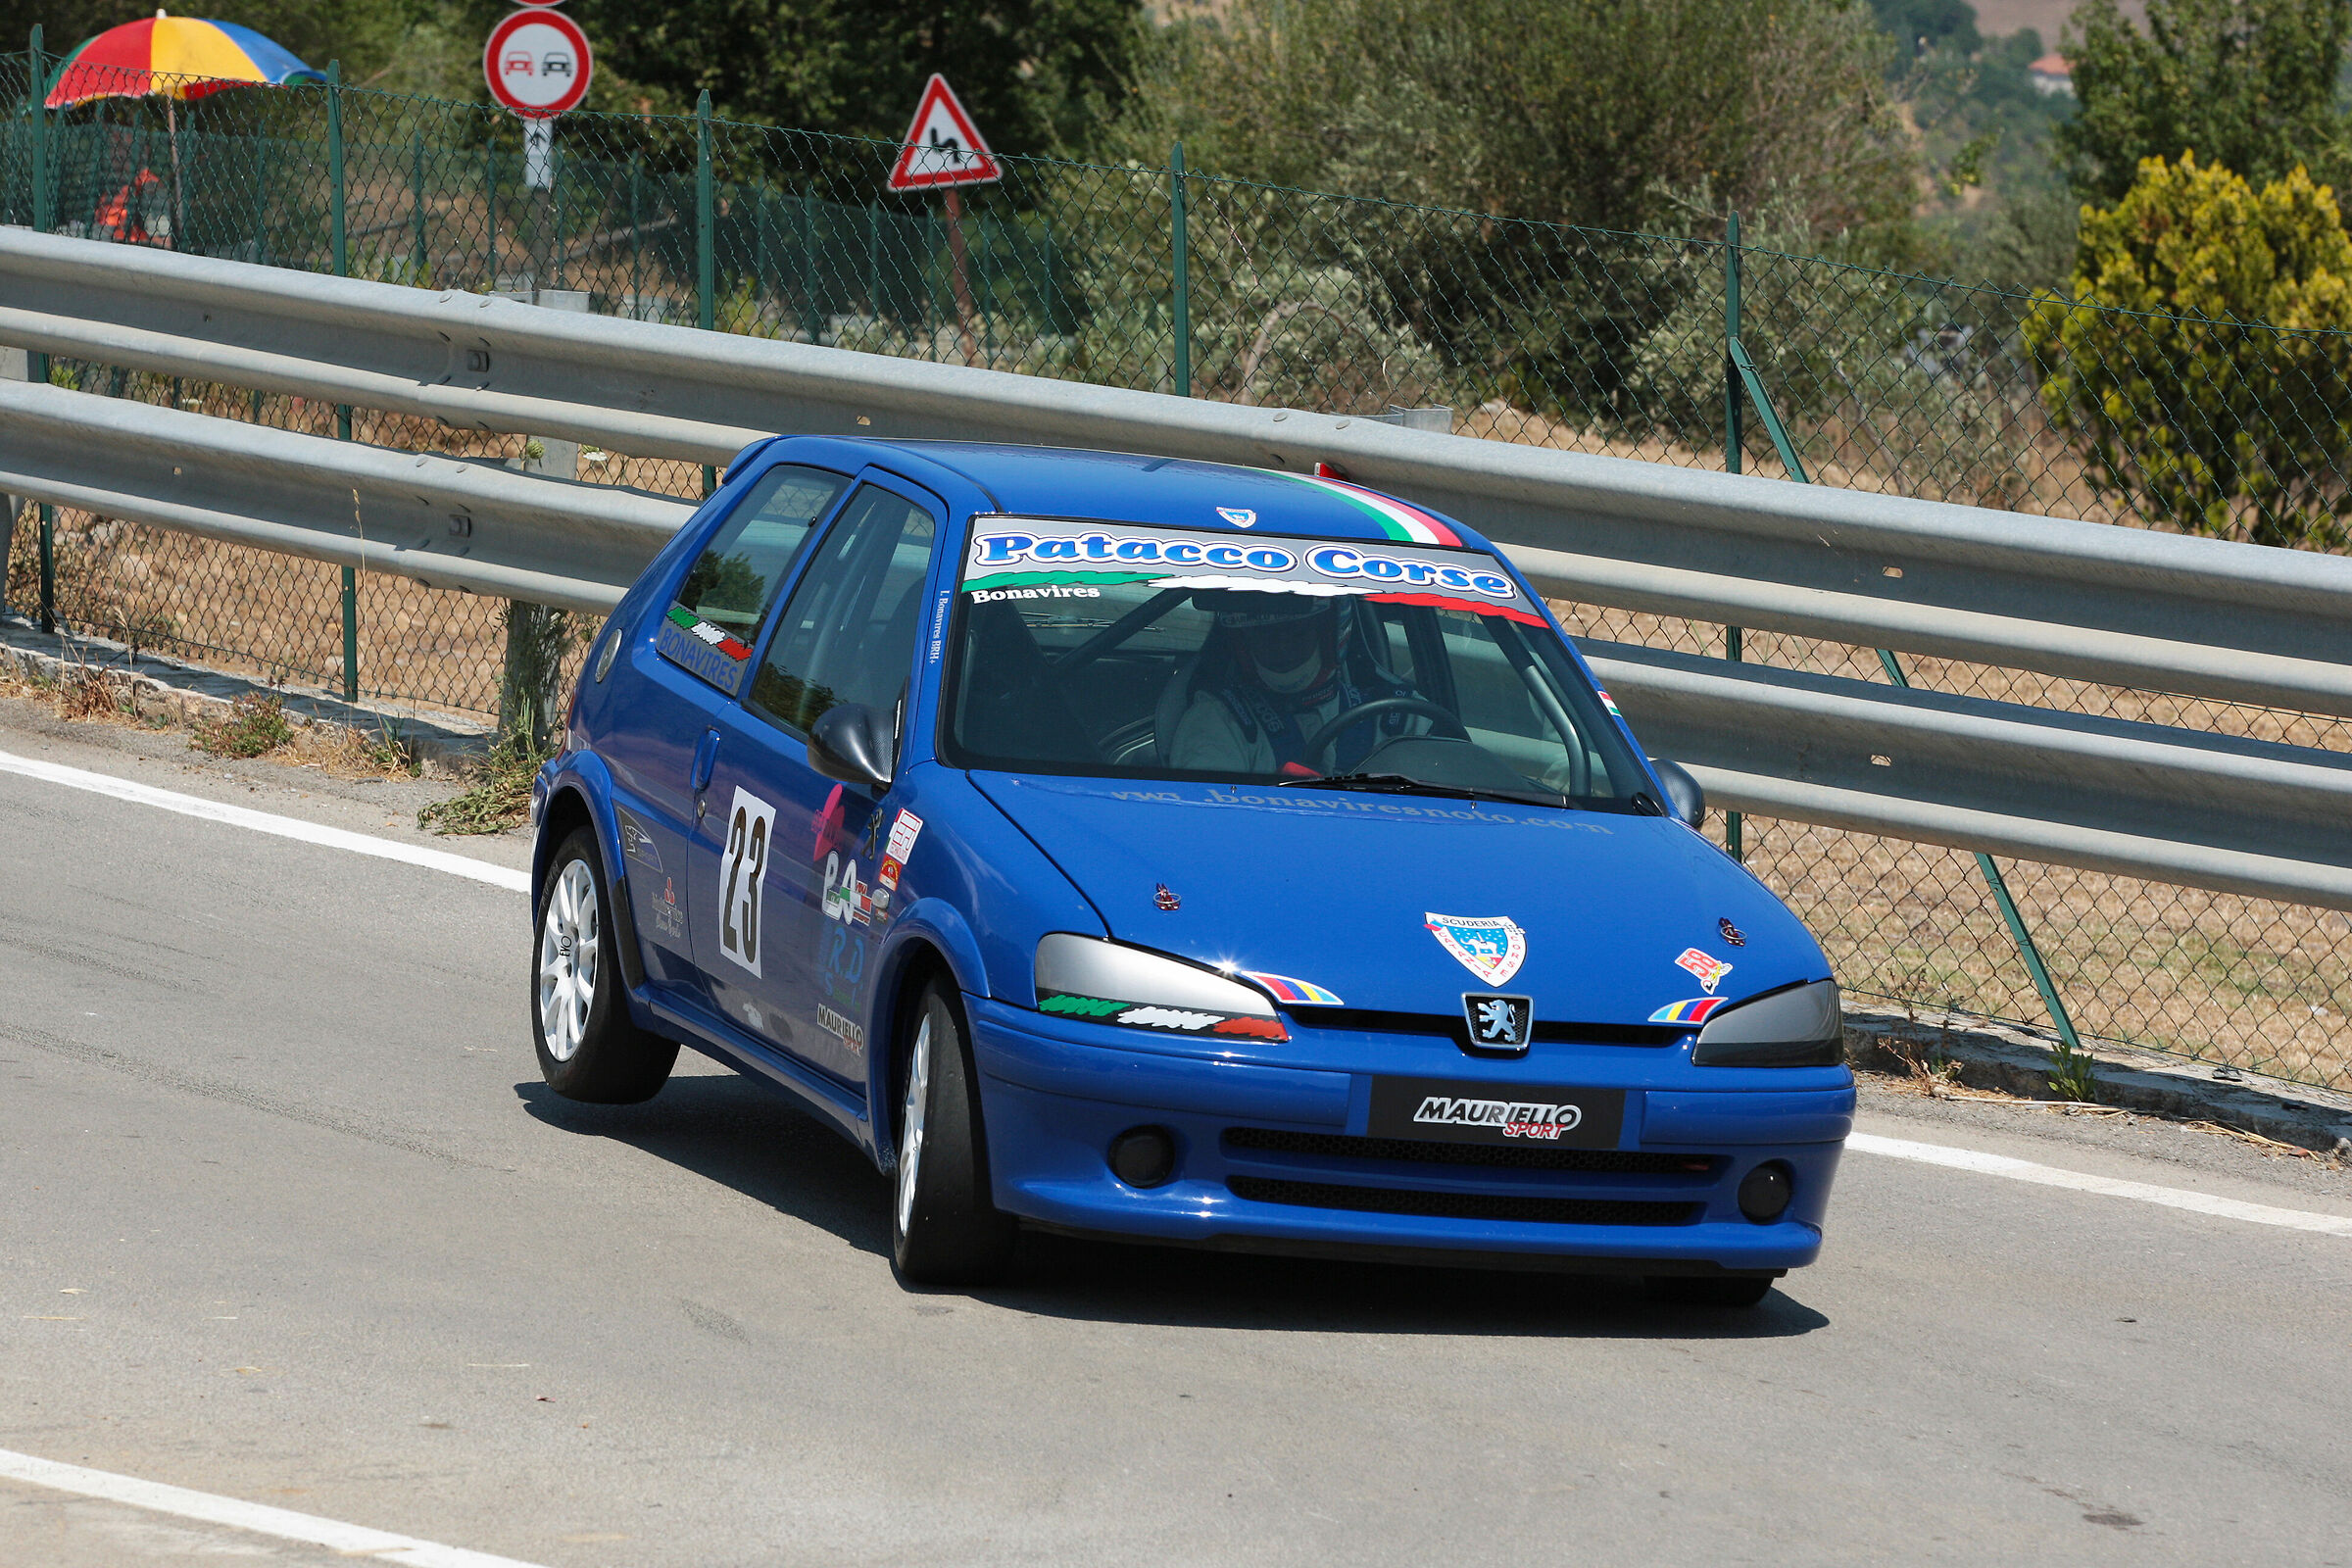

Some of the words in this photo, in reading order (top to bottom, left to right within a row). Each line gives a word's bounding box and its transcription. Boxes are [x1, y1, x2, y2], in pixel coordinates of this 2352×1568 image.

[976, 533, 1298, 571] Patacco
[1306, 546, 1515, 598] Corse
[971, 585, 1101, 604] Bonavires
[933, 597, 949, 639] Bonavires
[660, 627, 738, 690] BONAVIRES
[722, 806, 766, 964] 23
[1442, 916, 1501, 927] SCUDERIA
[559, 935, 572, 957] EVO
[1438, 931, 1492, 978] CATANIA
[1499, 935, 1521, 978] CORSE
[817, 1004, 863, 1050] MAURIELLO
[1415, 1098, 1580, 1128] MAURIELLO
[1503, 1121, 1567, 1139] SPORT
